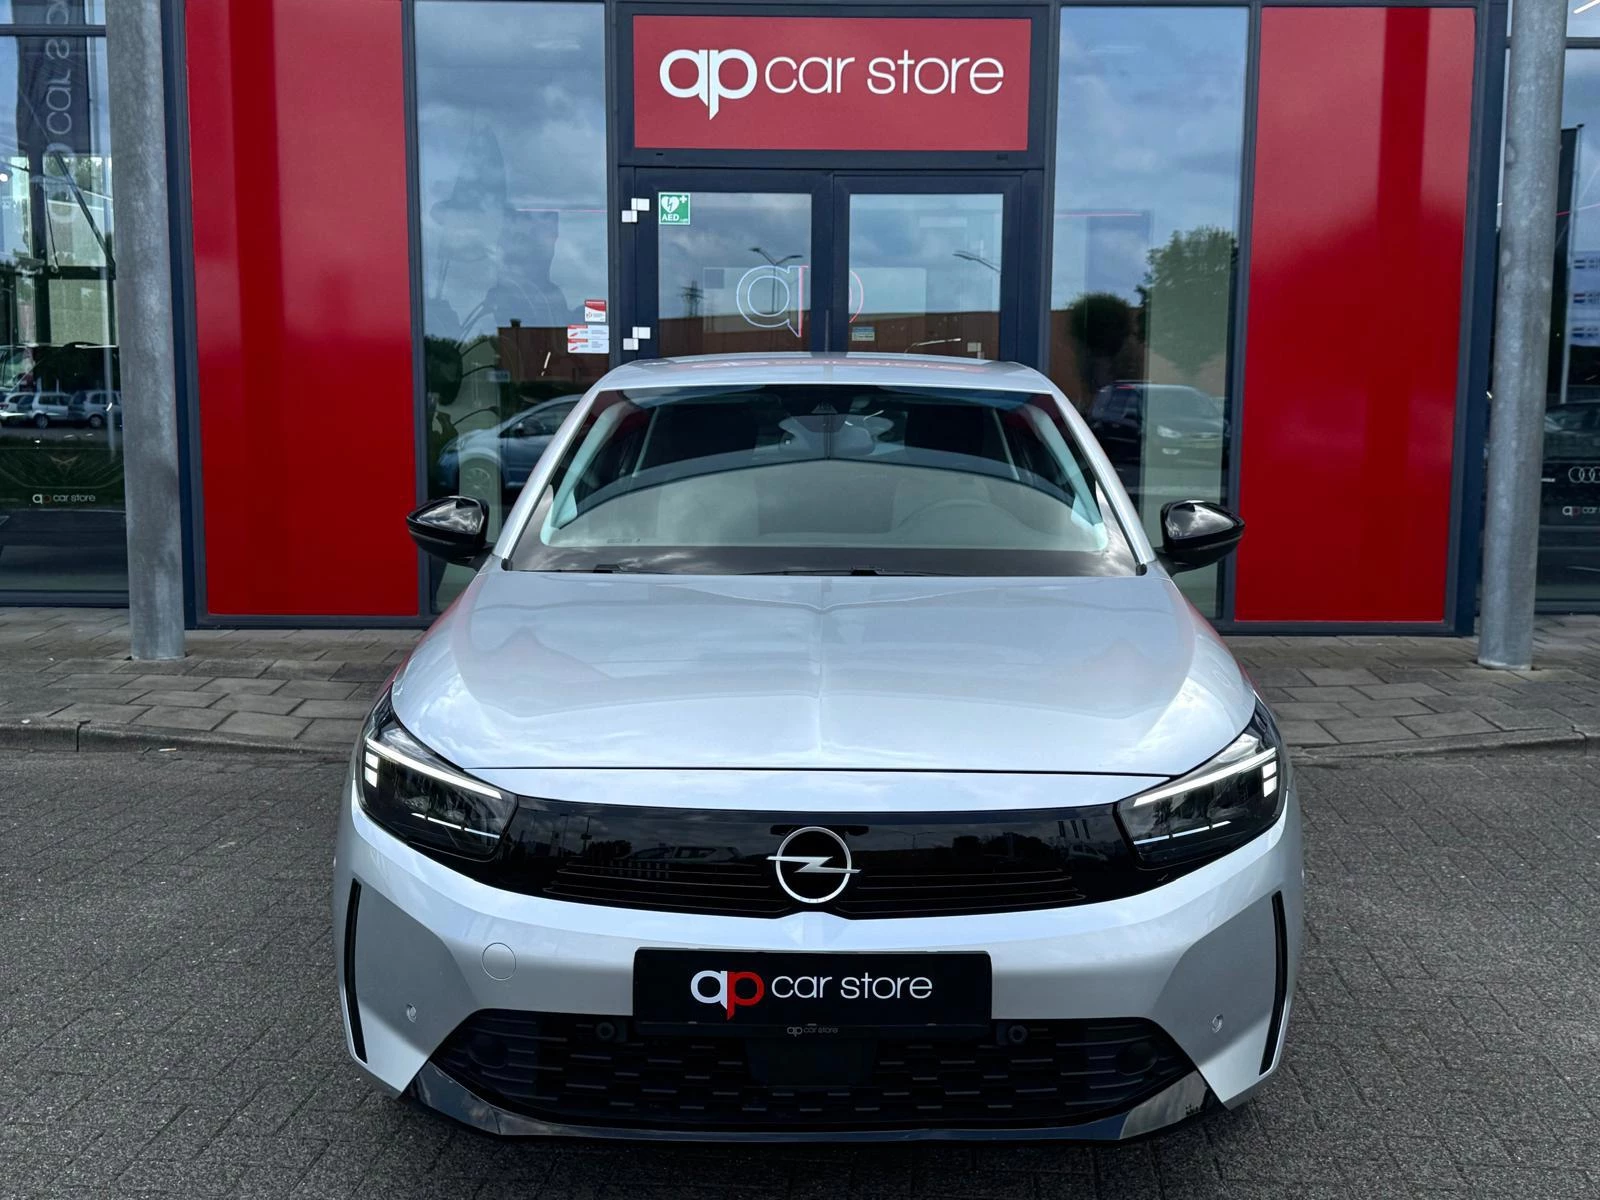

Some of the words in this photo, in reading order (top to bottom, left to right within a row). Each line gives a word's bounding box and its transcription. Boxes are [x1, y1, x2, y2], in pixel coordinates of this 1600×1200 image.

[659, 49, 758, 121] ap
[764, 56, 855, 95] car
[866, 49, 1005, 95] store
[661, 213, 680, 222] AED
[53, 494, 69, 502] car
[71, 493, 96, 502] store
[690, 970, 765, 1021] ap
[771, 975, 833, 999] car
[840, 972, 933, 1000] store
[786, 1026, 803, 1037] ap
